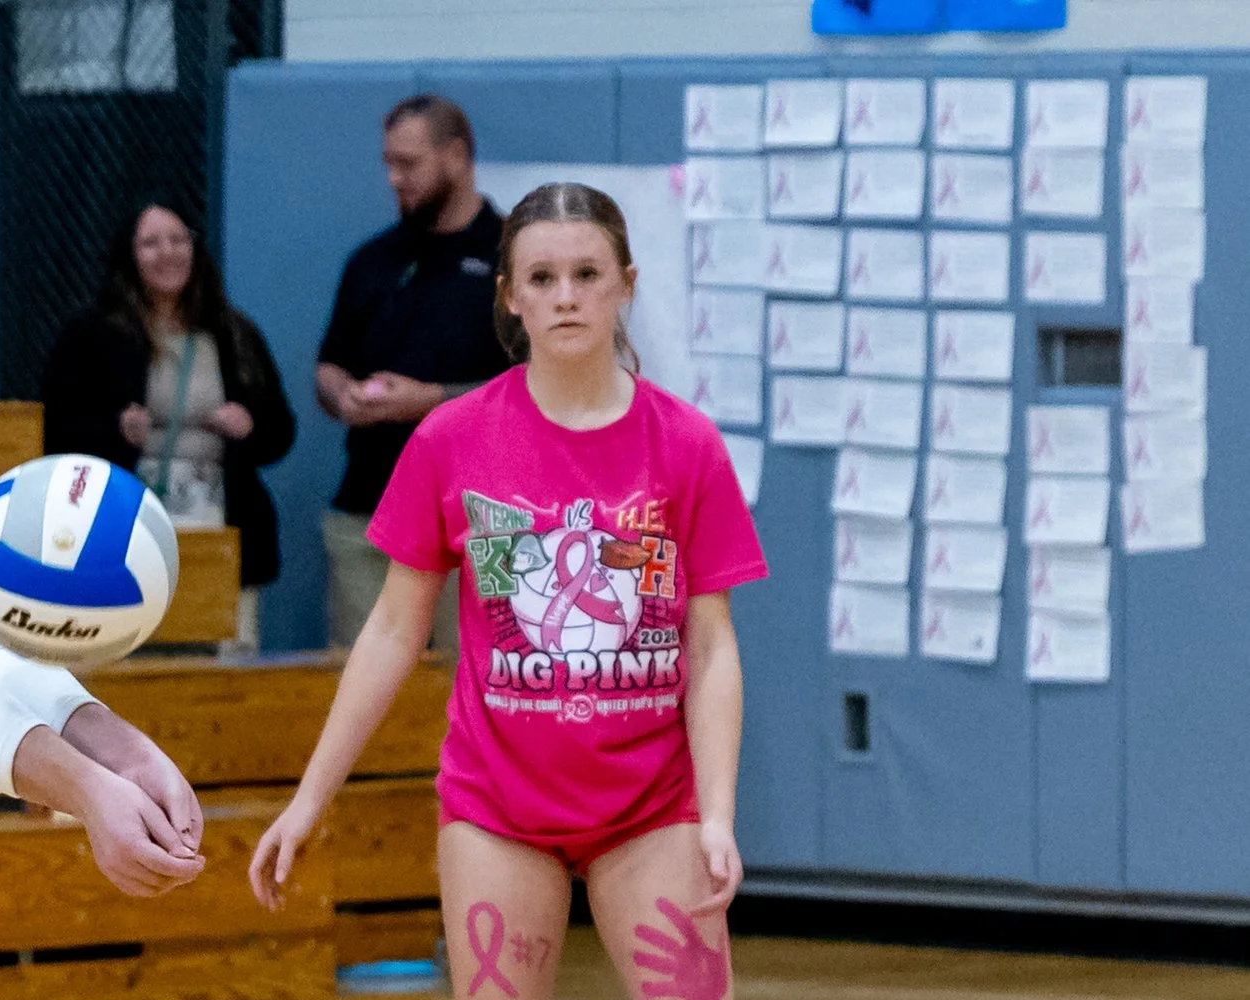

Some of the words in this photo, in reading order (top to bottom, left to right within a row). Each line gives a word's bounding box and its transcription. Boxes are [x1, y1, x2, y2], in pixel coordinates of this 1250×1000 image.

[566, 499, 593, 529] VS
[466, 535, 519, 596] K
[638, 535, 678, 599] H
[485, 648, 552, 691] DIG
[564, 648, 681, 692] PINK
